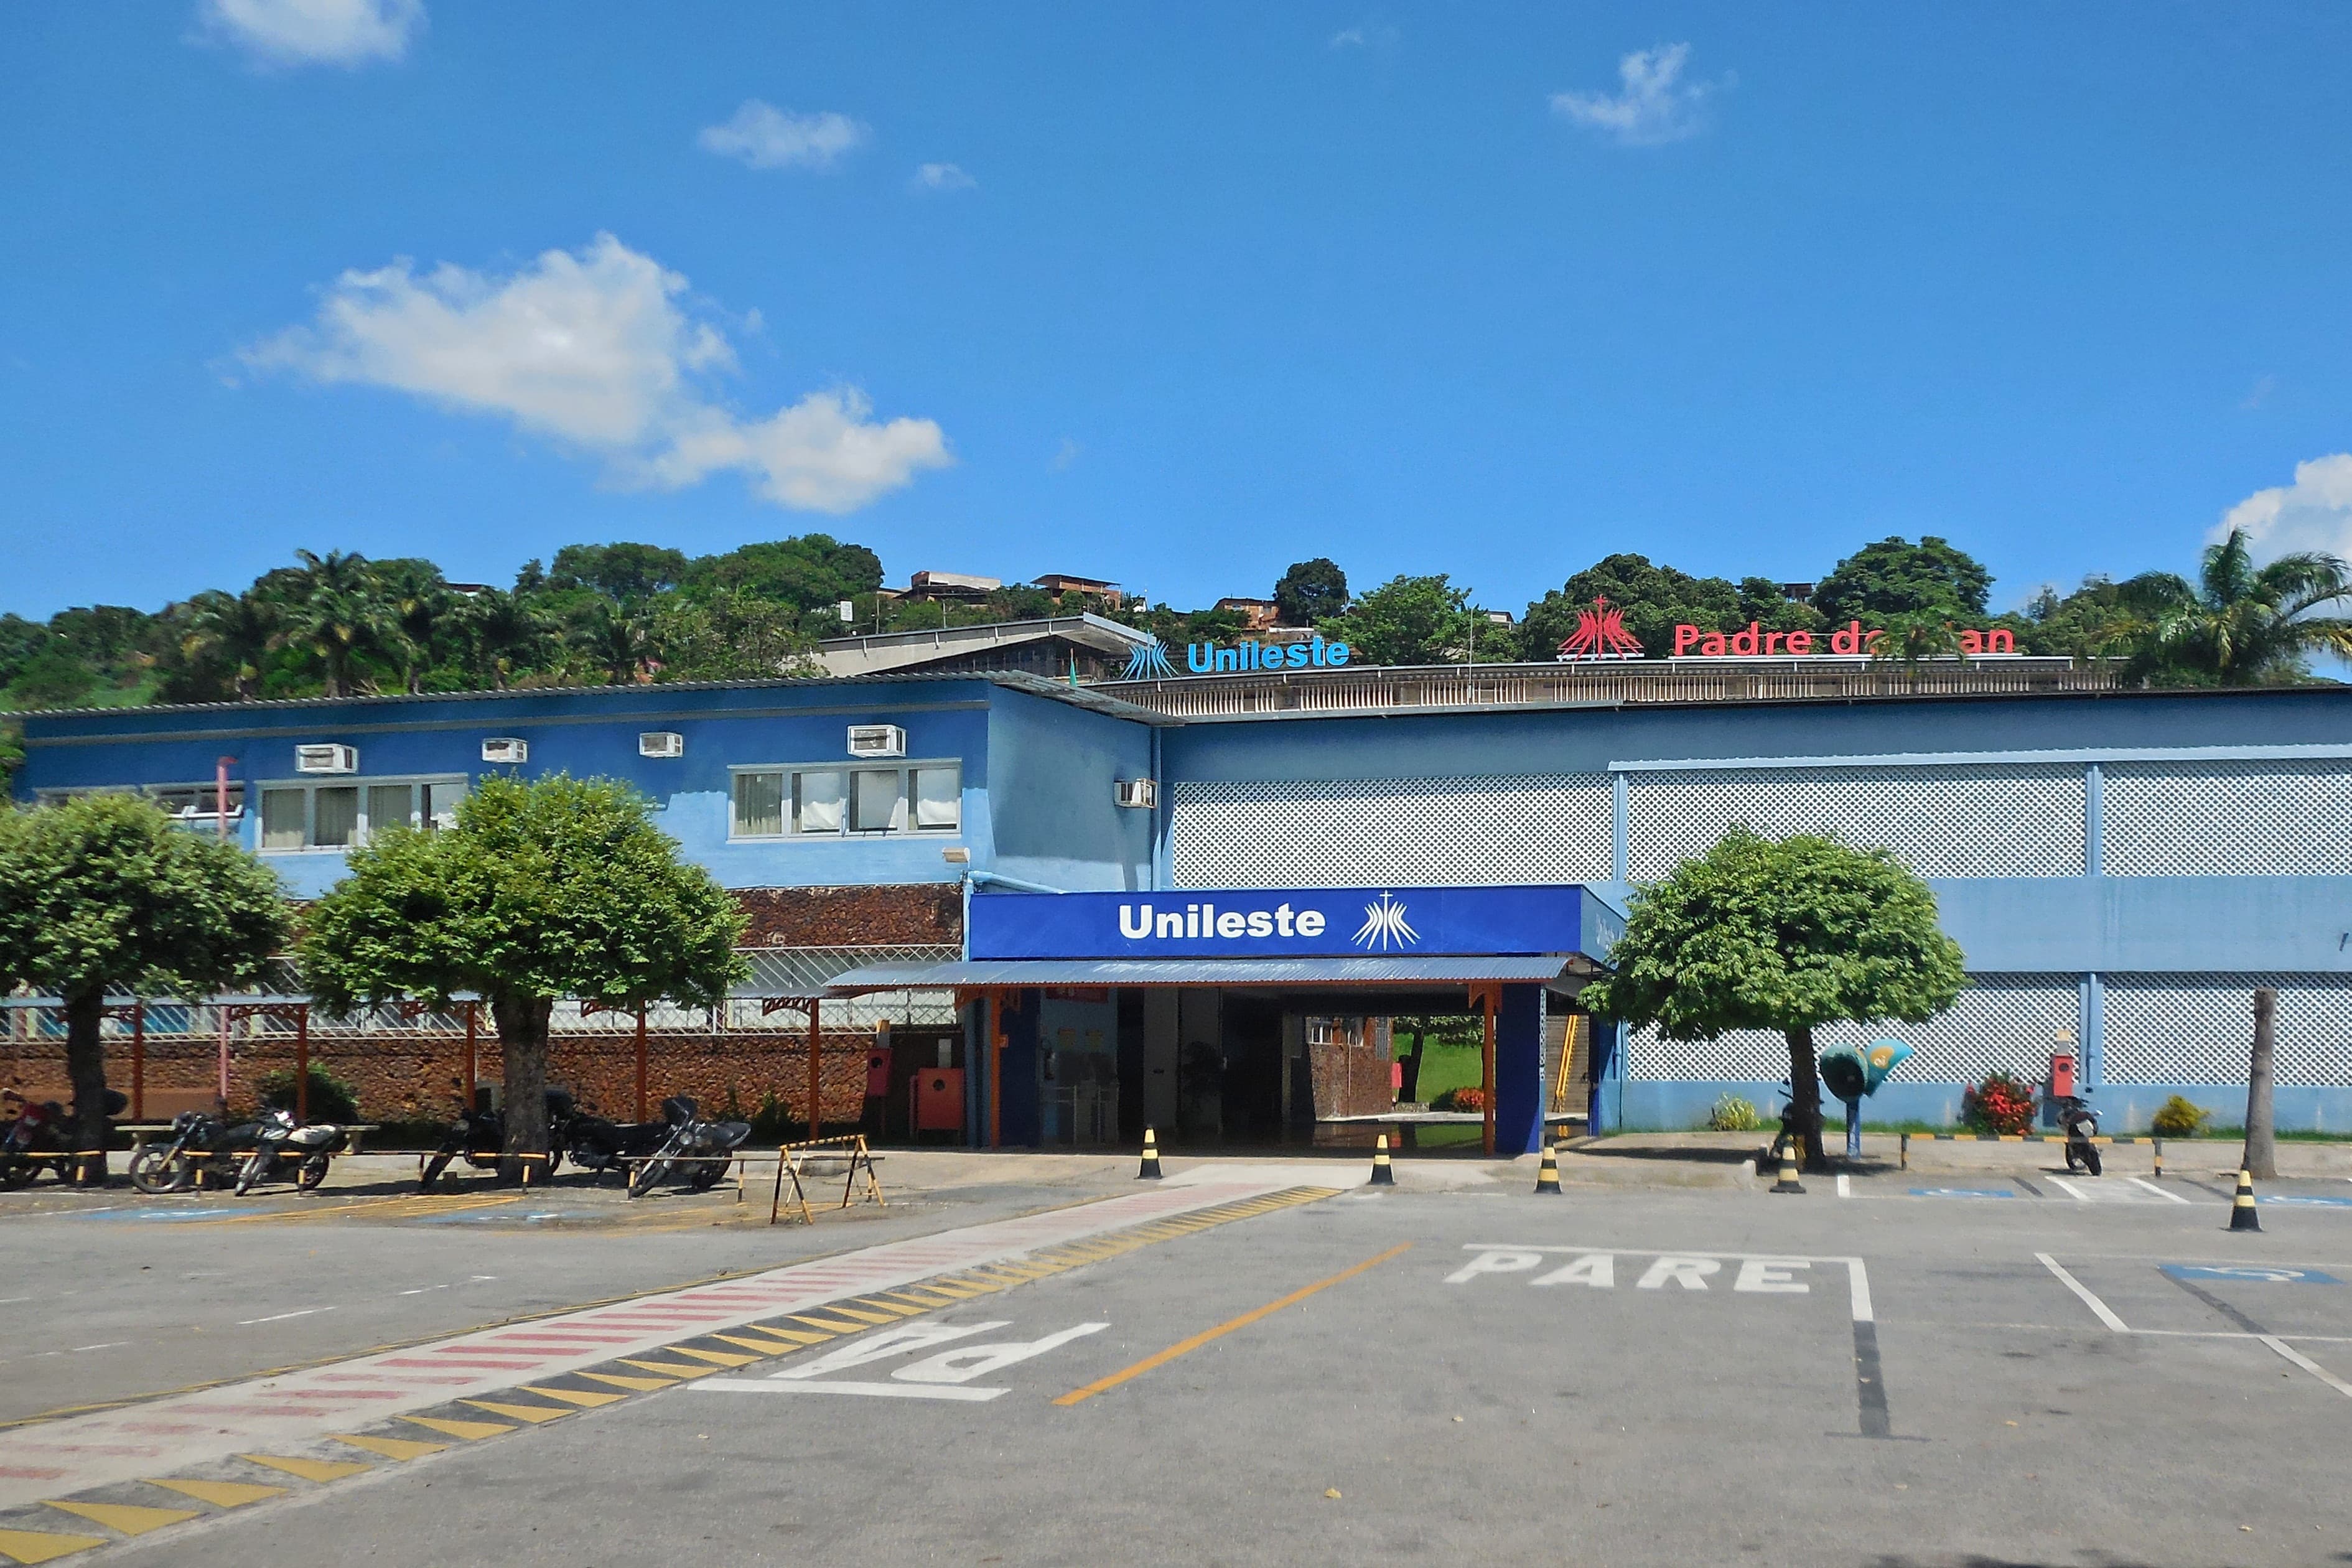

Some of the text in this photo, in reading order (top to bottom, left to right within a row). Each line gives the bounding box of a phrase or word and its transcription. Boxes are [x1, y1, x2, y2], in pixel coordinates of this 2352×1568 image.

[1188, 637, 1349, 673] Unileste
[1674, 622, 1813, 657] Padre
[1945, 622, 2015, 655] an
[1118, 902, 1326, 939] Unileste
[1442, 1252, 1810, 1292] PARE
